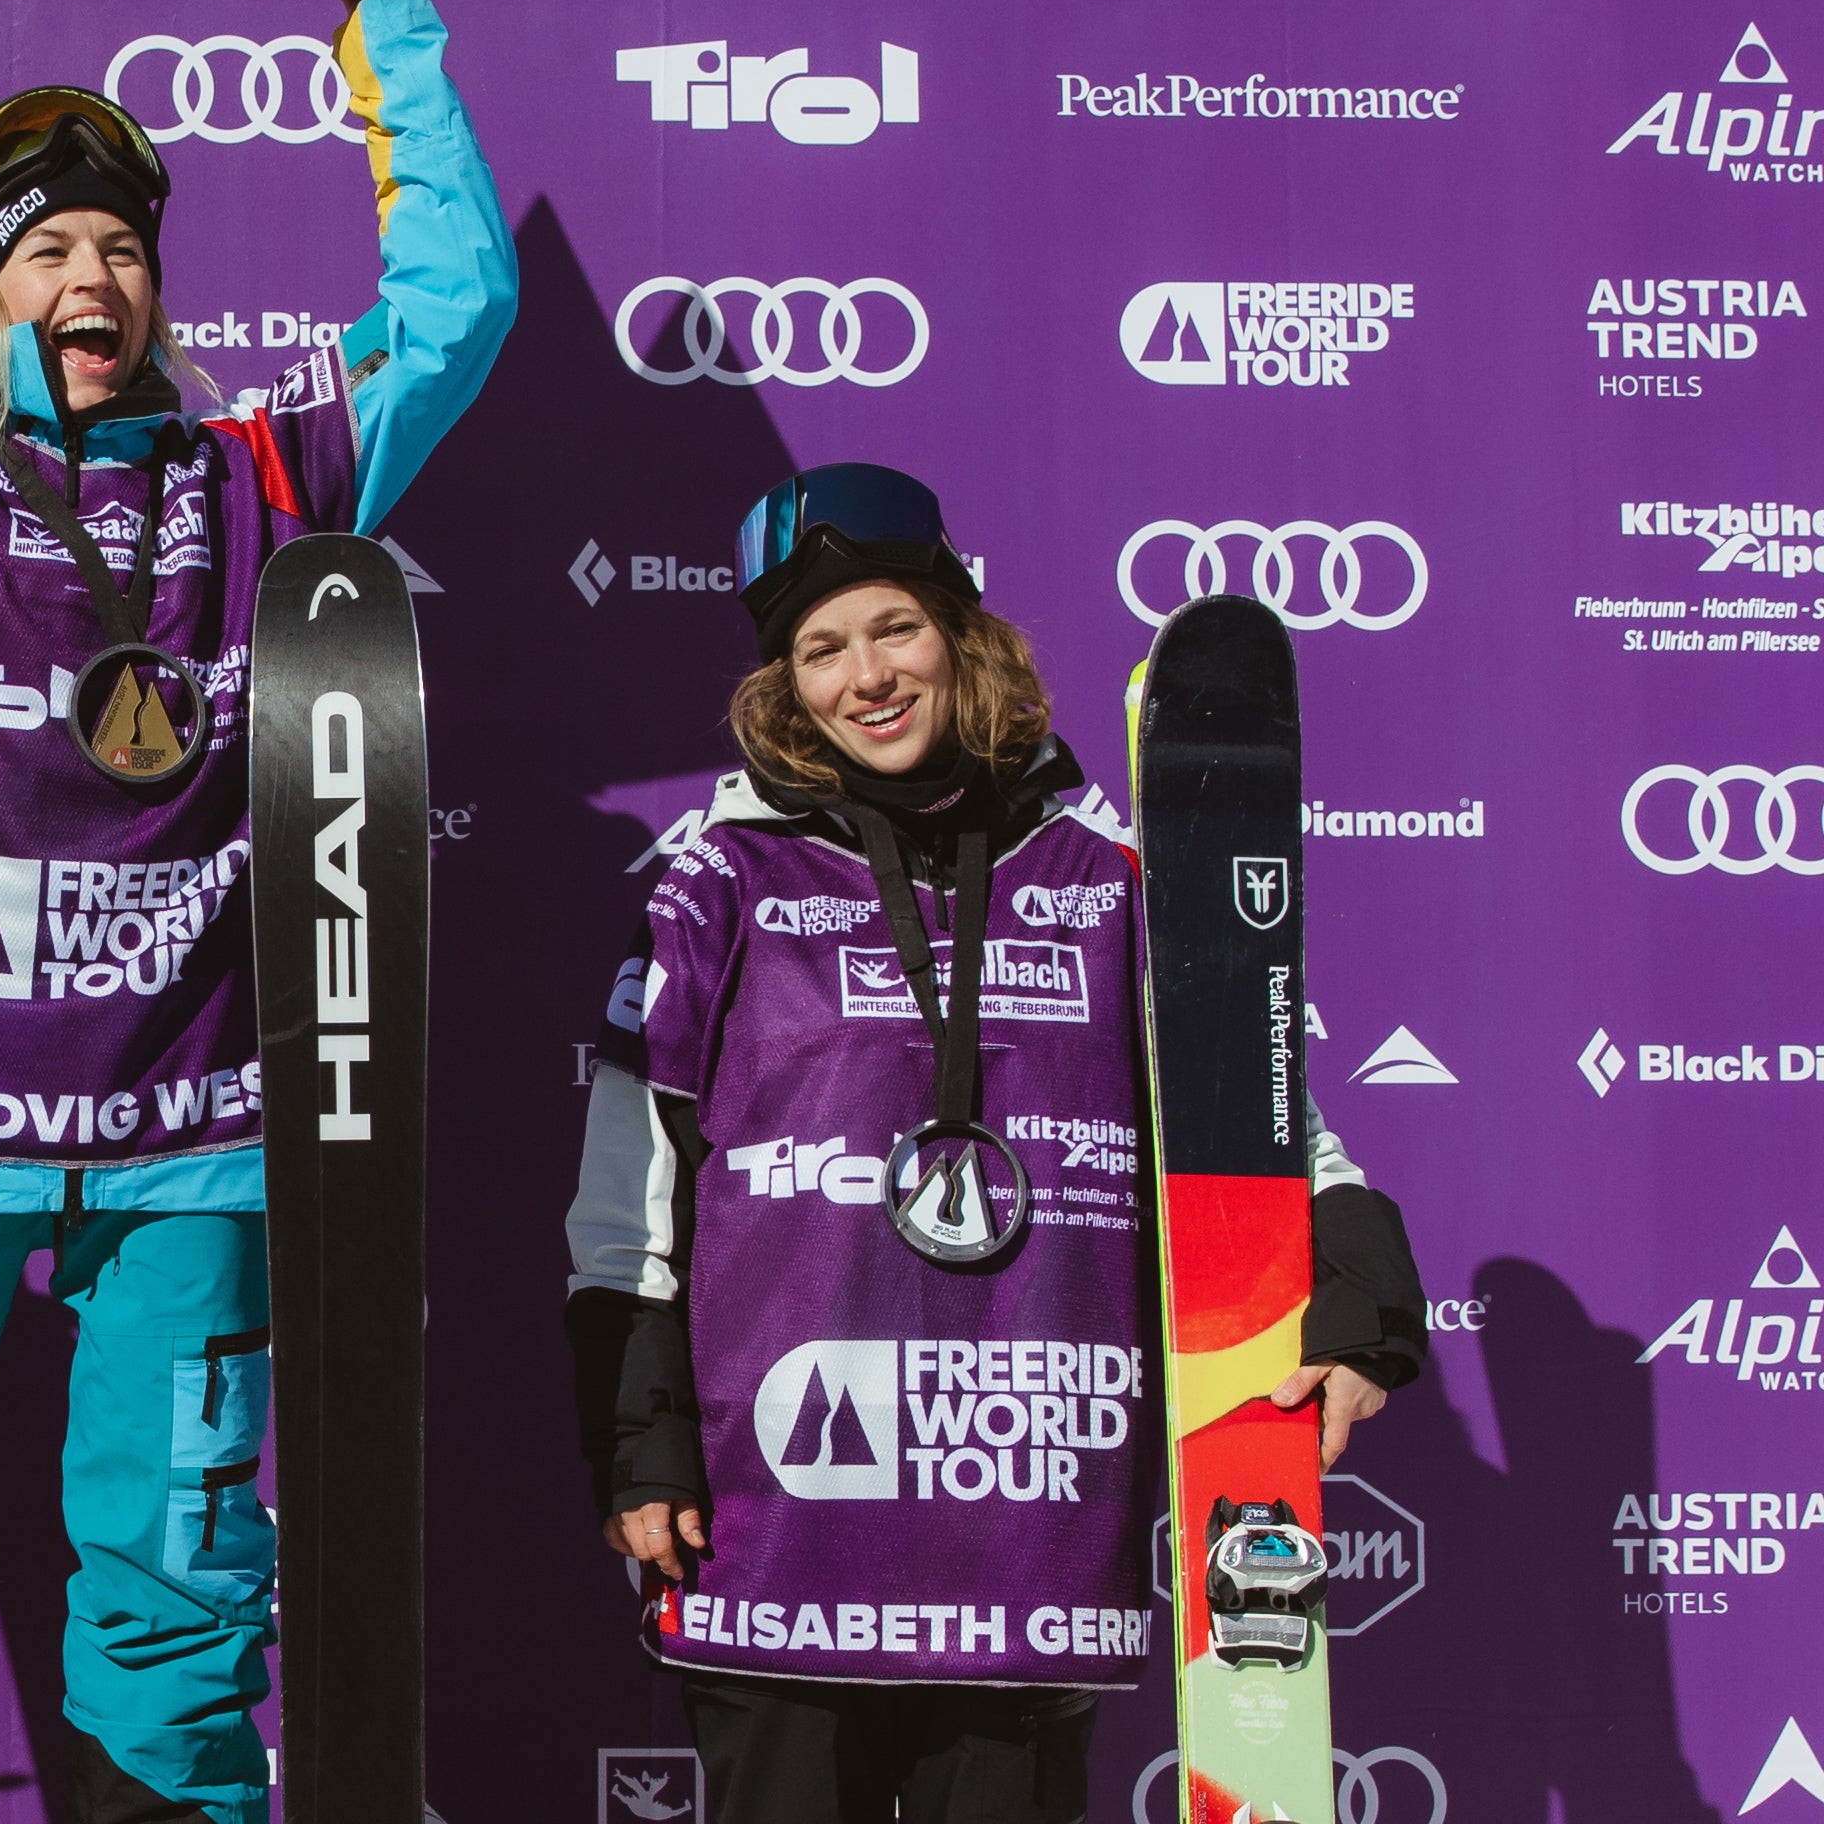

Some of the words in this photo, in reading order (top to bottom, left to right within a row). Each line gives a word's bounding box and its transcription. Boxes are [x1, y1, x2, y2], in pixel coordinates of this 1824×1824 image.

[1057, 74, 1462, 121] PeakPerformance
[1730, 164, 1824, 184] WATCH
[1228, 282, 1414, 318] FREERIDE
[1588, 279, 1807, 318] AUSTRIA
[1230, 317, 1390, 353] WORLD
[1588, 323, 1758, 360] TREND
[1229, 351, 1350, 387] TOUR
[1600, 376, 1702, 398] HOTELS
[631, 557, 733, 592] Blac
[1575, 597, 1686, 619] Fieberbrunn
[1702, 598, 1797, 620] Hochfilzen
[1623, 631, 1647, 651] St.
[1651, 630, 1703, 652] Ulrich
[1707, 636, 1737, 652] am
[1741, 631, 1819, 654] Pillersee
[801, 895, 881, 913] FREERIDE
[1052, 882, 1125, 903] FREERIDE
[1055, 896, 1117, 915] WORLD
[311, 691, 372, 1141] HEAD
[802, 908, 870, 924] WORLD
[802, 920, 853, 936] TOUR
[1057, 910, 1101, 930] TOUR
[1012, 1002, 1085, 1017] FIEBERBRUNN
[1268, 964, 1291, 1146] PeakPerformance
[1639, 1046, 1768, 1082] Black
[905, 1340, 1143, 1399] FREERIDE
[906, 1394, 1128, 1449] WORLD
[906, 1448, 1081, 1501] TOUR
[1613, 1538, 1786, 1576] TREND
[1624, 1592, 1728, 1614] HOTELS
[684, 1594, 1005, 1653] ELISABETH
